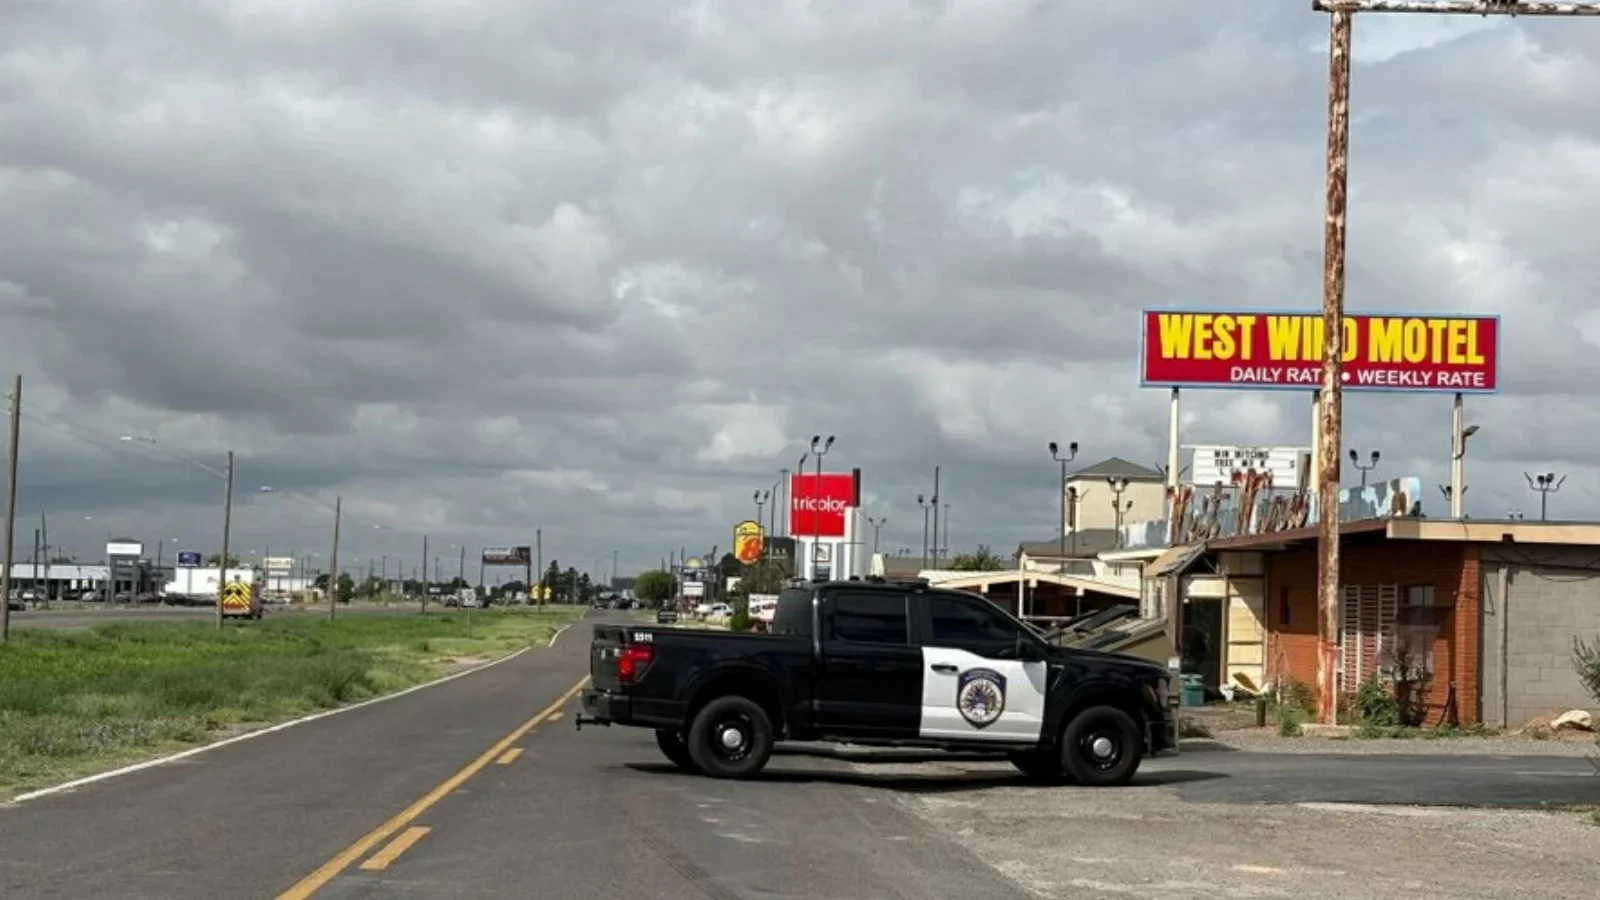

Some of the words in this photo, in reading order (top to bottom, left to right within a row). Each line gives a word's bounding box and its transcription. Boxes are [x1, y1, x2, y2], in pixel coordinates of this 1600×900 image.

[1159, 314, 1256, 360] WEST
[1368, 317, 1485, 365] MOTEL
[1230, 366, 1282, 382] DAILY
[1286, 367, 1323, 383] RAT
[1357, 368, 1433, 386] WEEKLY
[1437, 370, 1485, 387] RATE
[792, 495, 847, 512] tricolor
